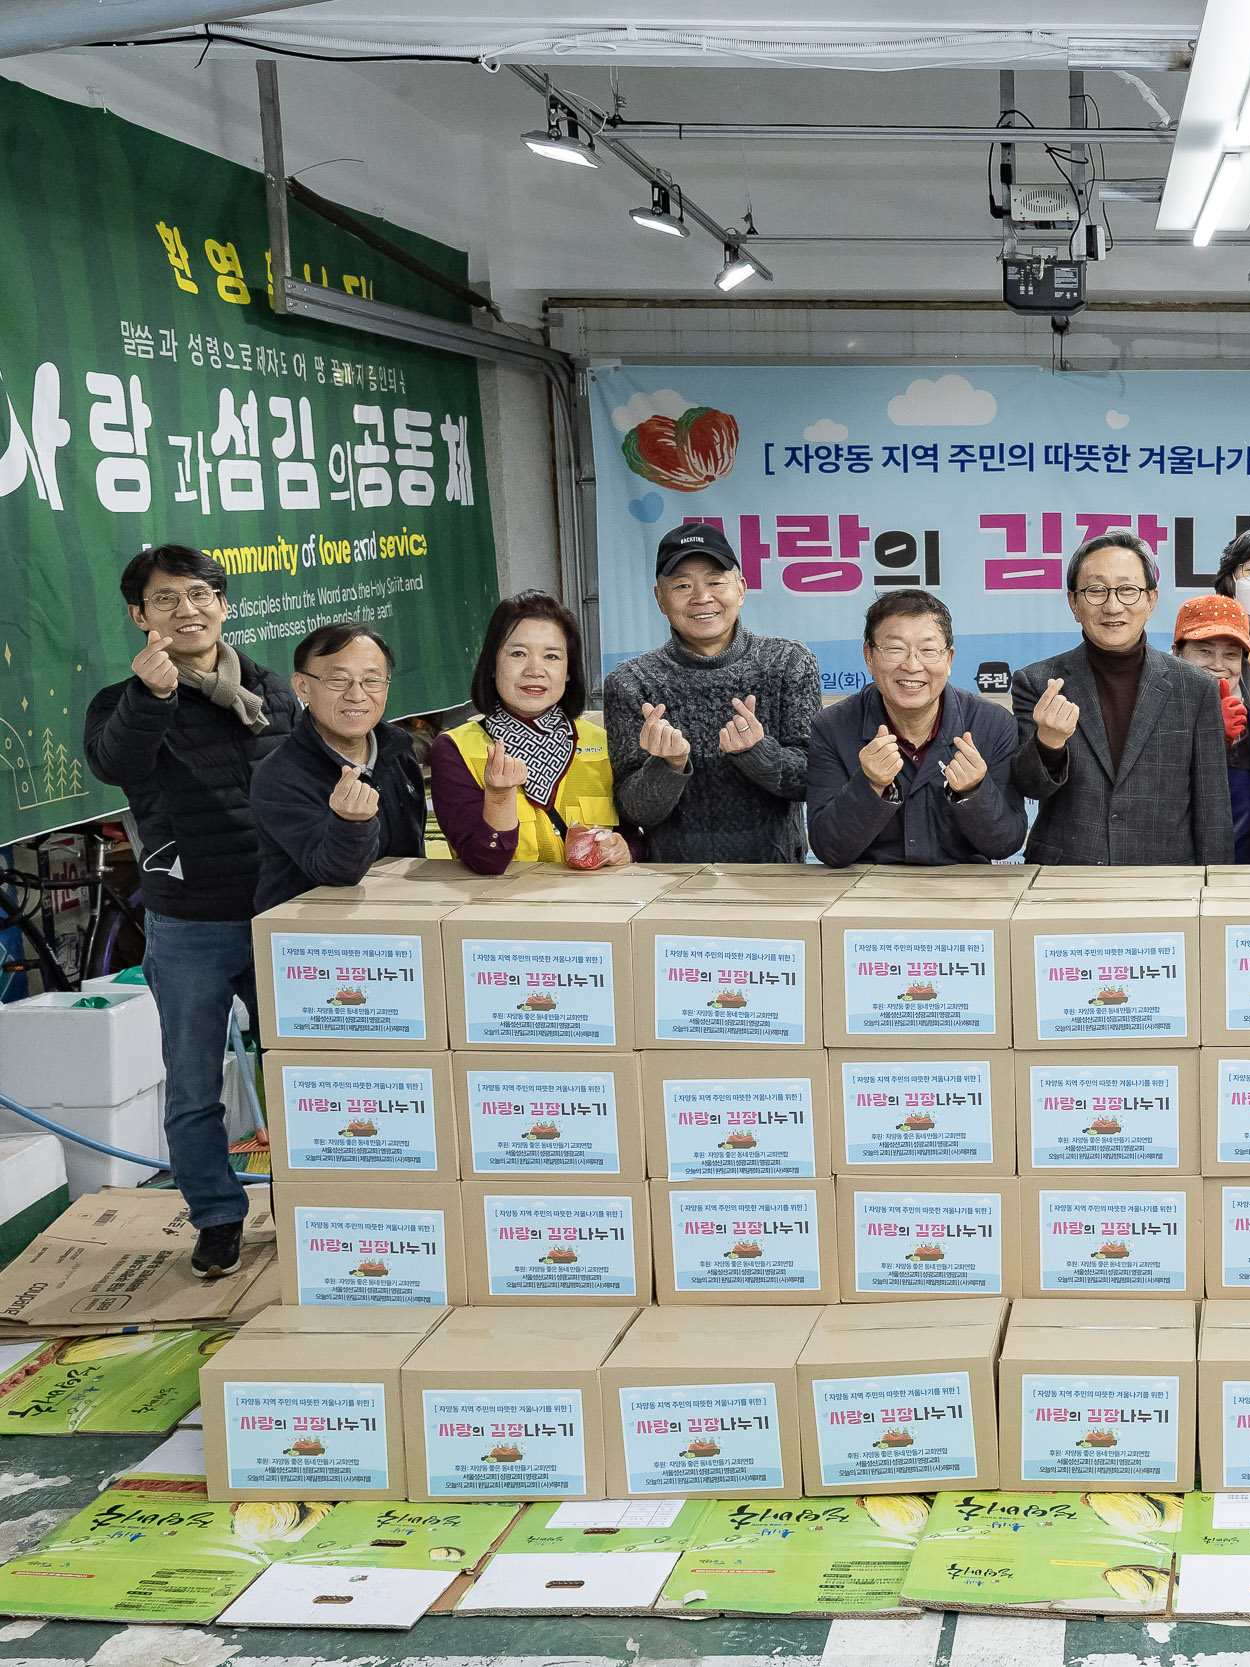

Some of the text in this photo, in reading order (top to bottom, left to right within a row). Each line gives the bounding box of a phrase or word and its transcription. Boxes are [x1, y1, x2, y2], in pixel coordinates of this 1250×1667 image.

[187, 332, 253, 372] 성령으로
[352, 403, 475, 508] 공동체
[784, 443, 873, 474] 자양동
[881, 443, 939, 473] 지역
[948, 442, 1034, 473] 주민의
[1044, 442, 1131, 474] 따뜻한
[302, 534, 316, 568] of
[319, 534, 351, 566] love
[353, 530, 377, 562] and
[240, 595, 280, 618] disciples
[282, 592, 302, 611] thru
[303, 589, 316, 609] the
[317, 586, 341, 606] Word
[358, 582, 370, 599] the
[405, 573, 424, 591] and
[257, 620, 306, 641] witnesses
[306, 616, 318, 633] to
[362, 604, 375, 621] the
[820, 671, 867, 690] 일(화)
[978, 672, 1009, 689] 주관
[286, 966, 413, 981] 사랑의 김장나누기
[668, 968, 795, 985] 사랑의 김장나누기
[1048, 965, 1176, 981] 사랑의 김장나누기
[297, 1098, 424, 1113] 사랑의 김장나누기
[1043, 1097, 1169, 1110] 사랑의 김장나누기
[678, 1111, 803, 1125] 사랑의 김장나누기
[499, 1227, 624, 1240] 사랑의 김장나누기
[867, 1223, 991, 1237] 사랑의 김장나누기
[240, 1416, 375, 1431] 사랑의 김장나누기
[1035, 1408, 1168, 1423] 사랑의 김장나누기
[636, 1416, 769, 1434] 사랑의 김장나누기
